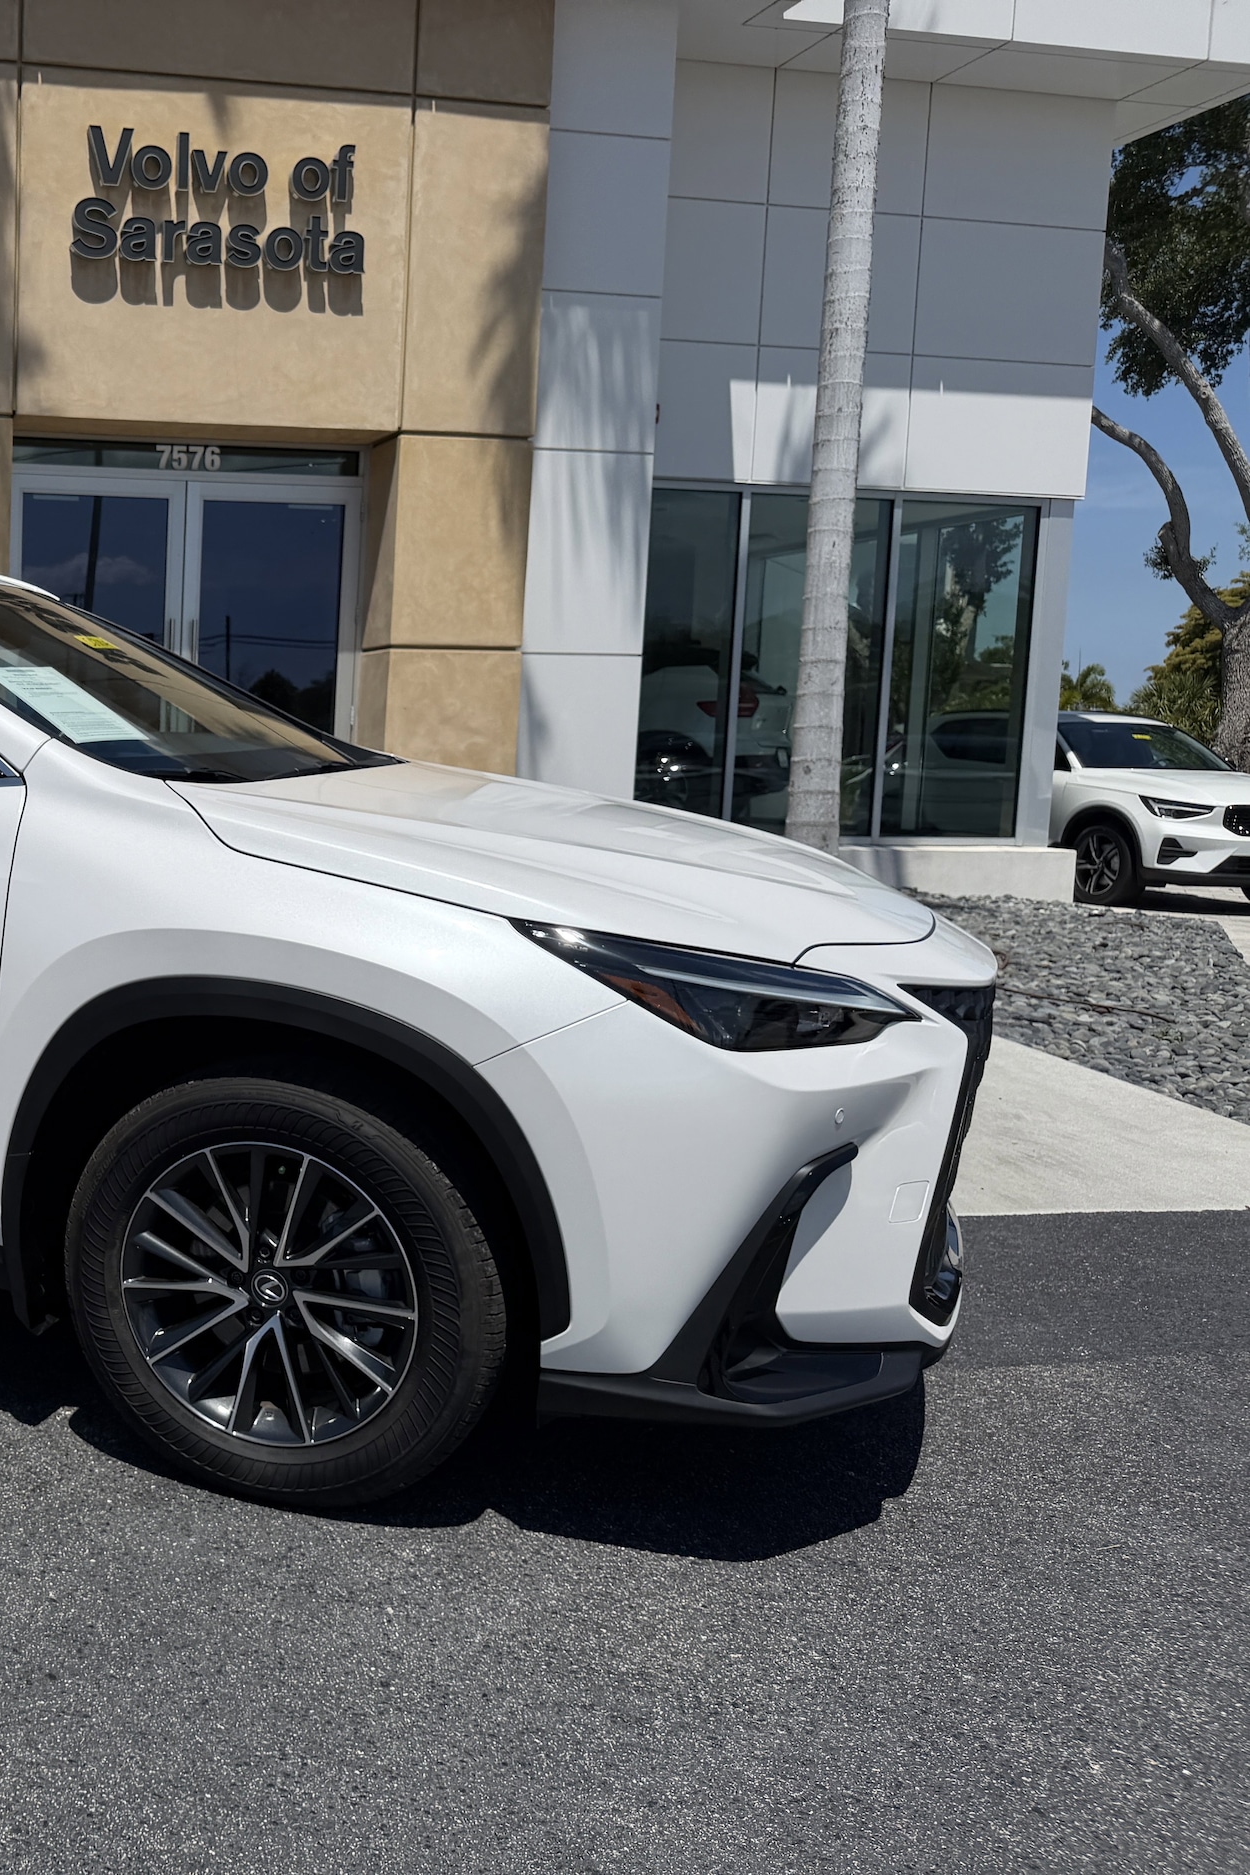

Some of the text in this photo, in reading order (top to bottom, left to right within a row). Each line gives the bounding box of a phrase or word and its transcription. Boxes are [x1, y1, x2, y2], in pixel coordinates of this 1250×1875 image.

[87, 124, 356, 203] Volvo of
[69, 197, 365, 275] Sarasota
[155, 444, 222, 472] 7576
